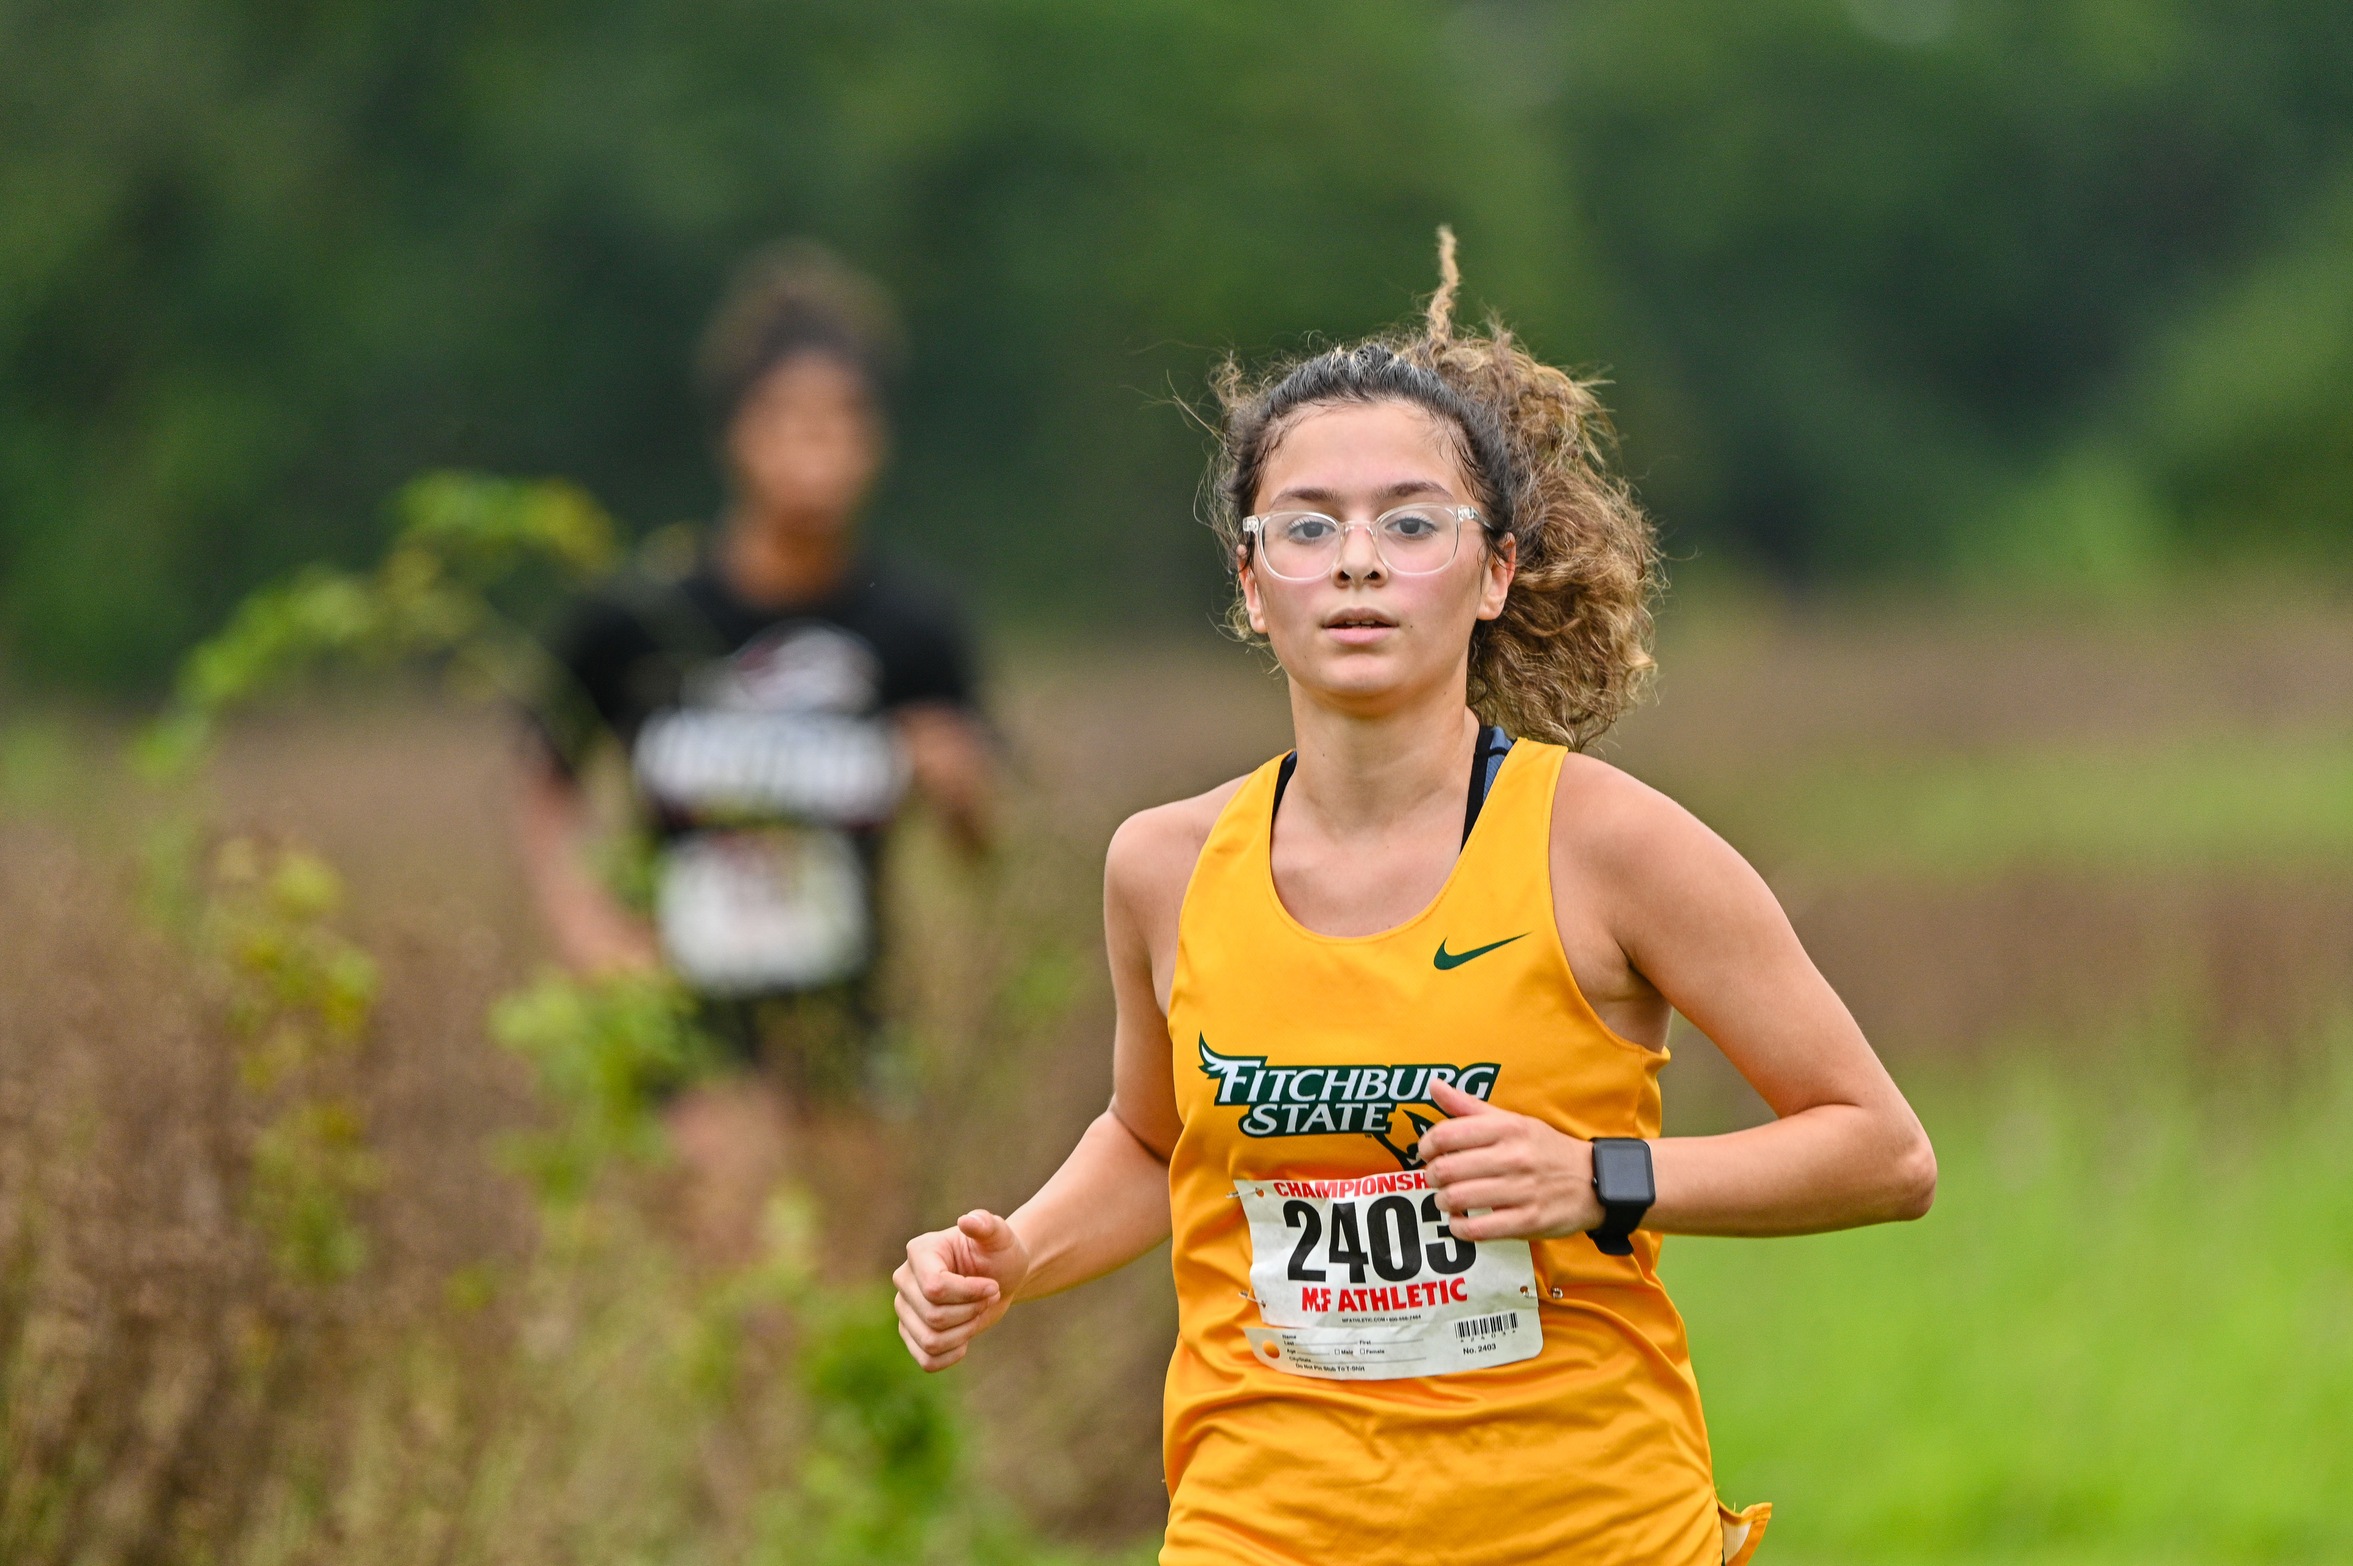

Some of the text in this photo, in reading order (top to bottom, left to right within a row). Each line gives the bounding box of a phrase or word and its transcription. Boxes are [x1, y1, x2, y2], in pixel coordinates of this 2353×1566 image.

[1200, 1044, 1496, 1103] FITCHBURG
[1242, 1102, 1392, 1135] STATE
[1273, 1173, 1431, 1199] CHAMPIONSH
[1283, 1193, 1477, 1284] 2403
[1337, 1277, 1468, 1313] ATHLETIC
[1463, 1343, 1497, 1355] No. 2403
